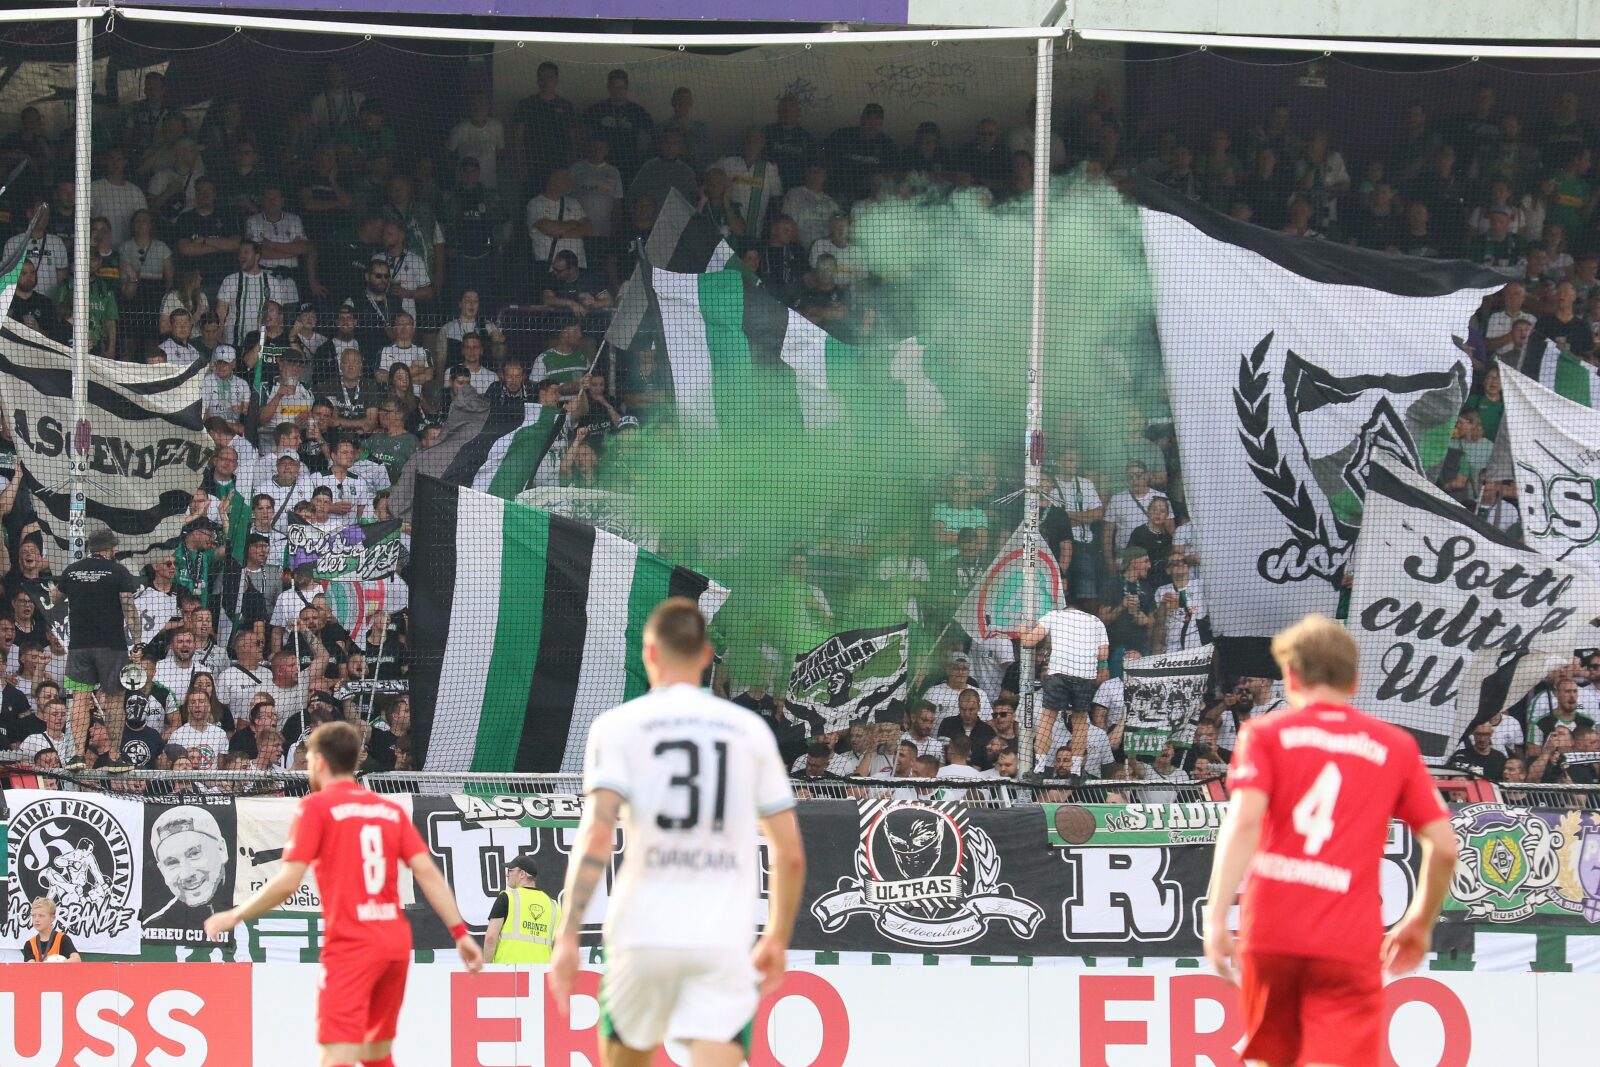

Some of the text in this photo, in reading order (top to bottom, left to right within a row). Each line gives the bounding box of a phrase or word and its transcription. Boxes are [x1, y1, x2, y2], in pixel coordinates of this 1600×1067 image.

[464, 792, 584, 822] ASCE
[653, 739, 728, 832] 31
[1292, 760, 1342, 856] 4
[60, 801, 130, 907] FRONTLINE
[360, 824, 387, 895] 8
[876, 879, 952, 900] ULTRAS
[141, 928, 184, 942] MEREU
[186, 930, 204, 942] CU
[522, 920, 548, 933] ORDNER
[450, 970, 850, 1067] ERO
[1079, 974, 1472, 1067] ERO
